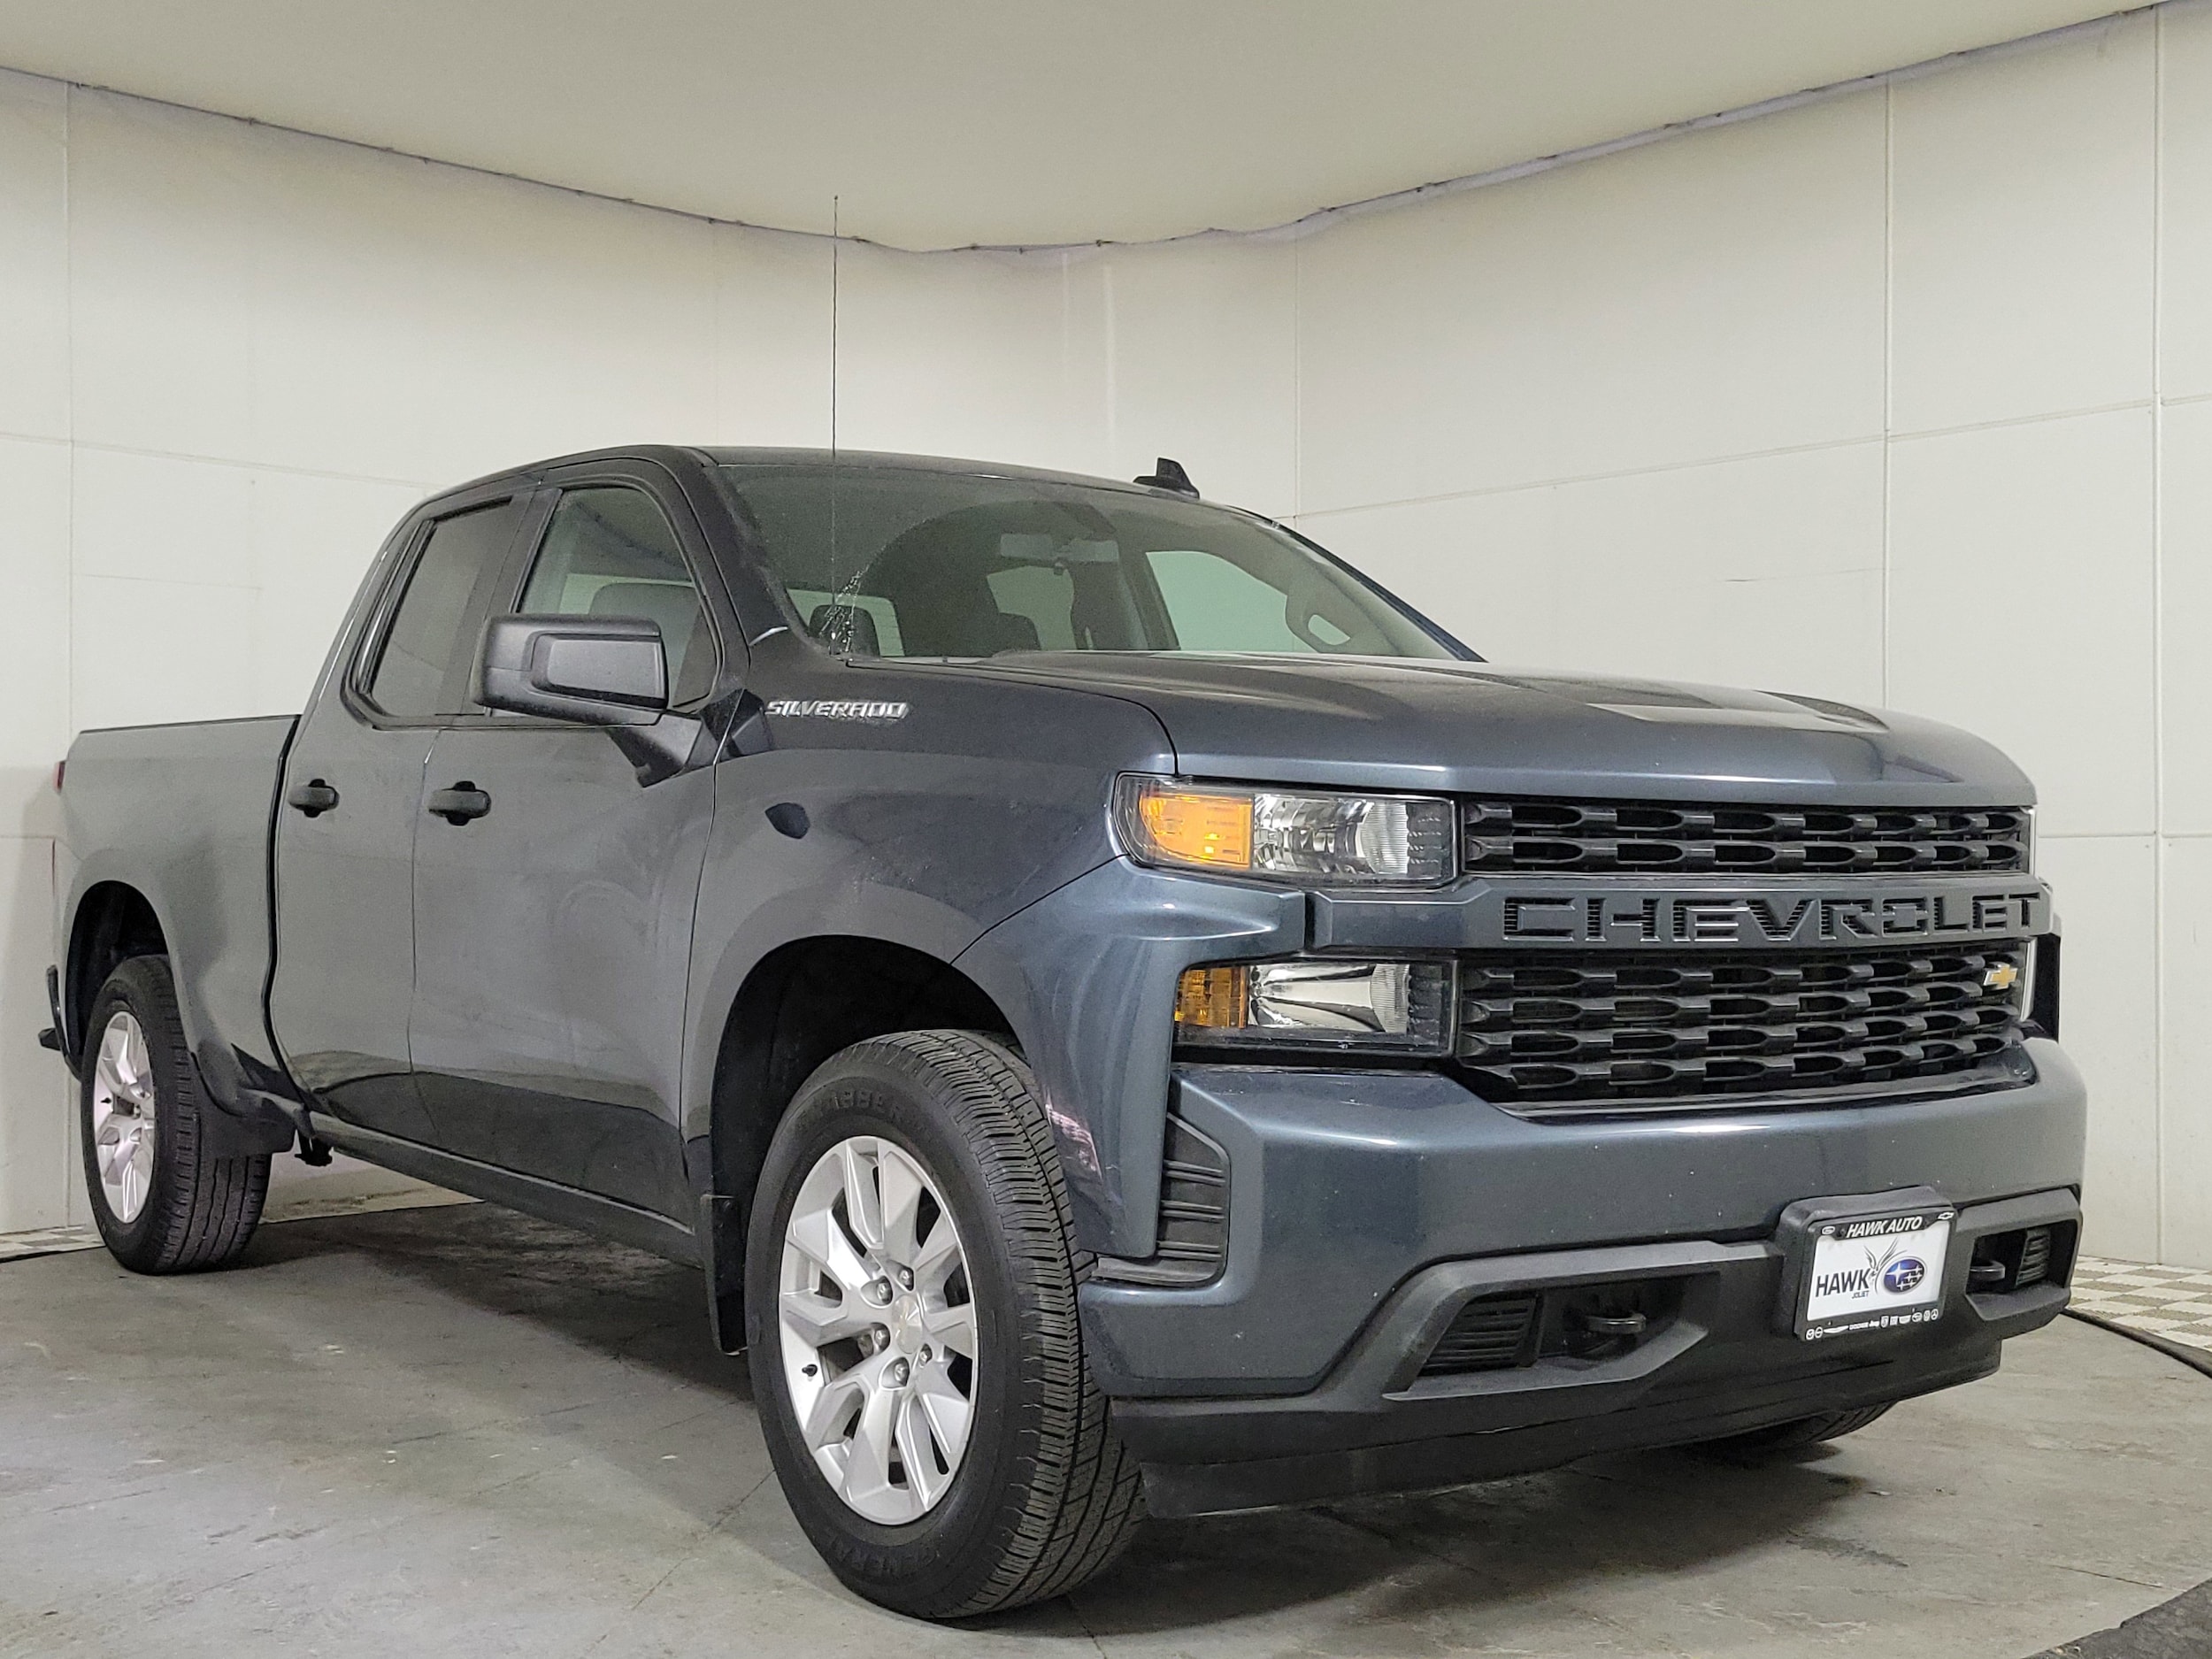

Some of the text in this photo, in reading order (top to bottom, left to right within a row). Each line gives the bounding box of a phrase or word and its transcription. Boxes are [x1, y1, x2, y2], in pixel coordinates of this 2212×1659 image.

[764, 700, 909, 719] SILVERADO
[1503, 891, 2040, 943] CHEVROLET
[1846, 1220, 1888, 1238] HAWK
[1886, 1216, 1923, 1233] AUTO
[1816, 1267, 1870, 1298] HAWK
